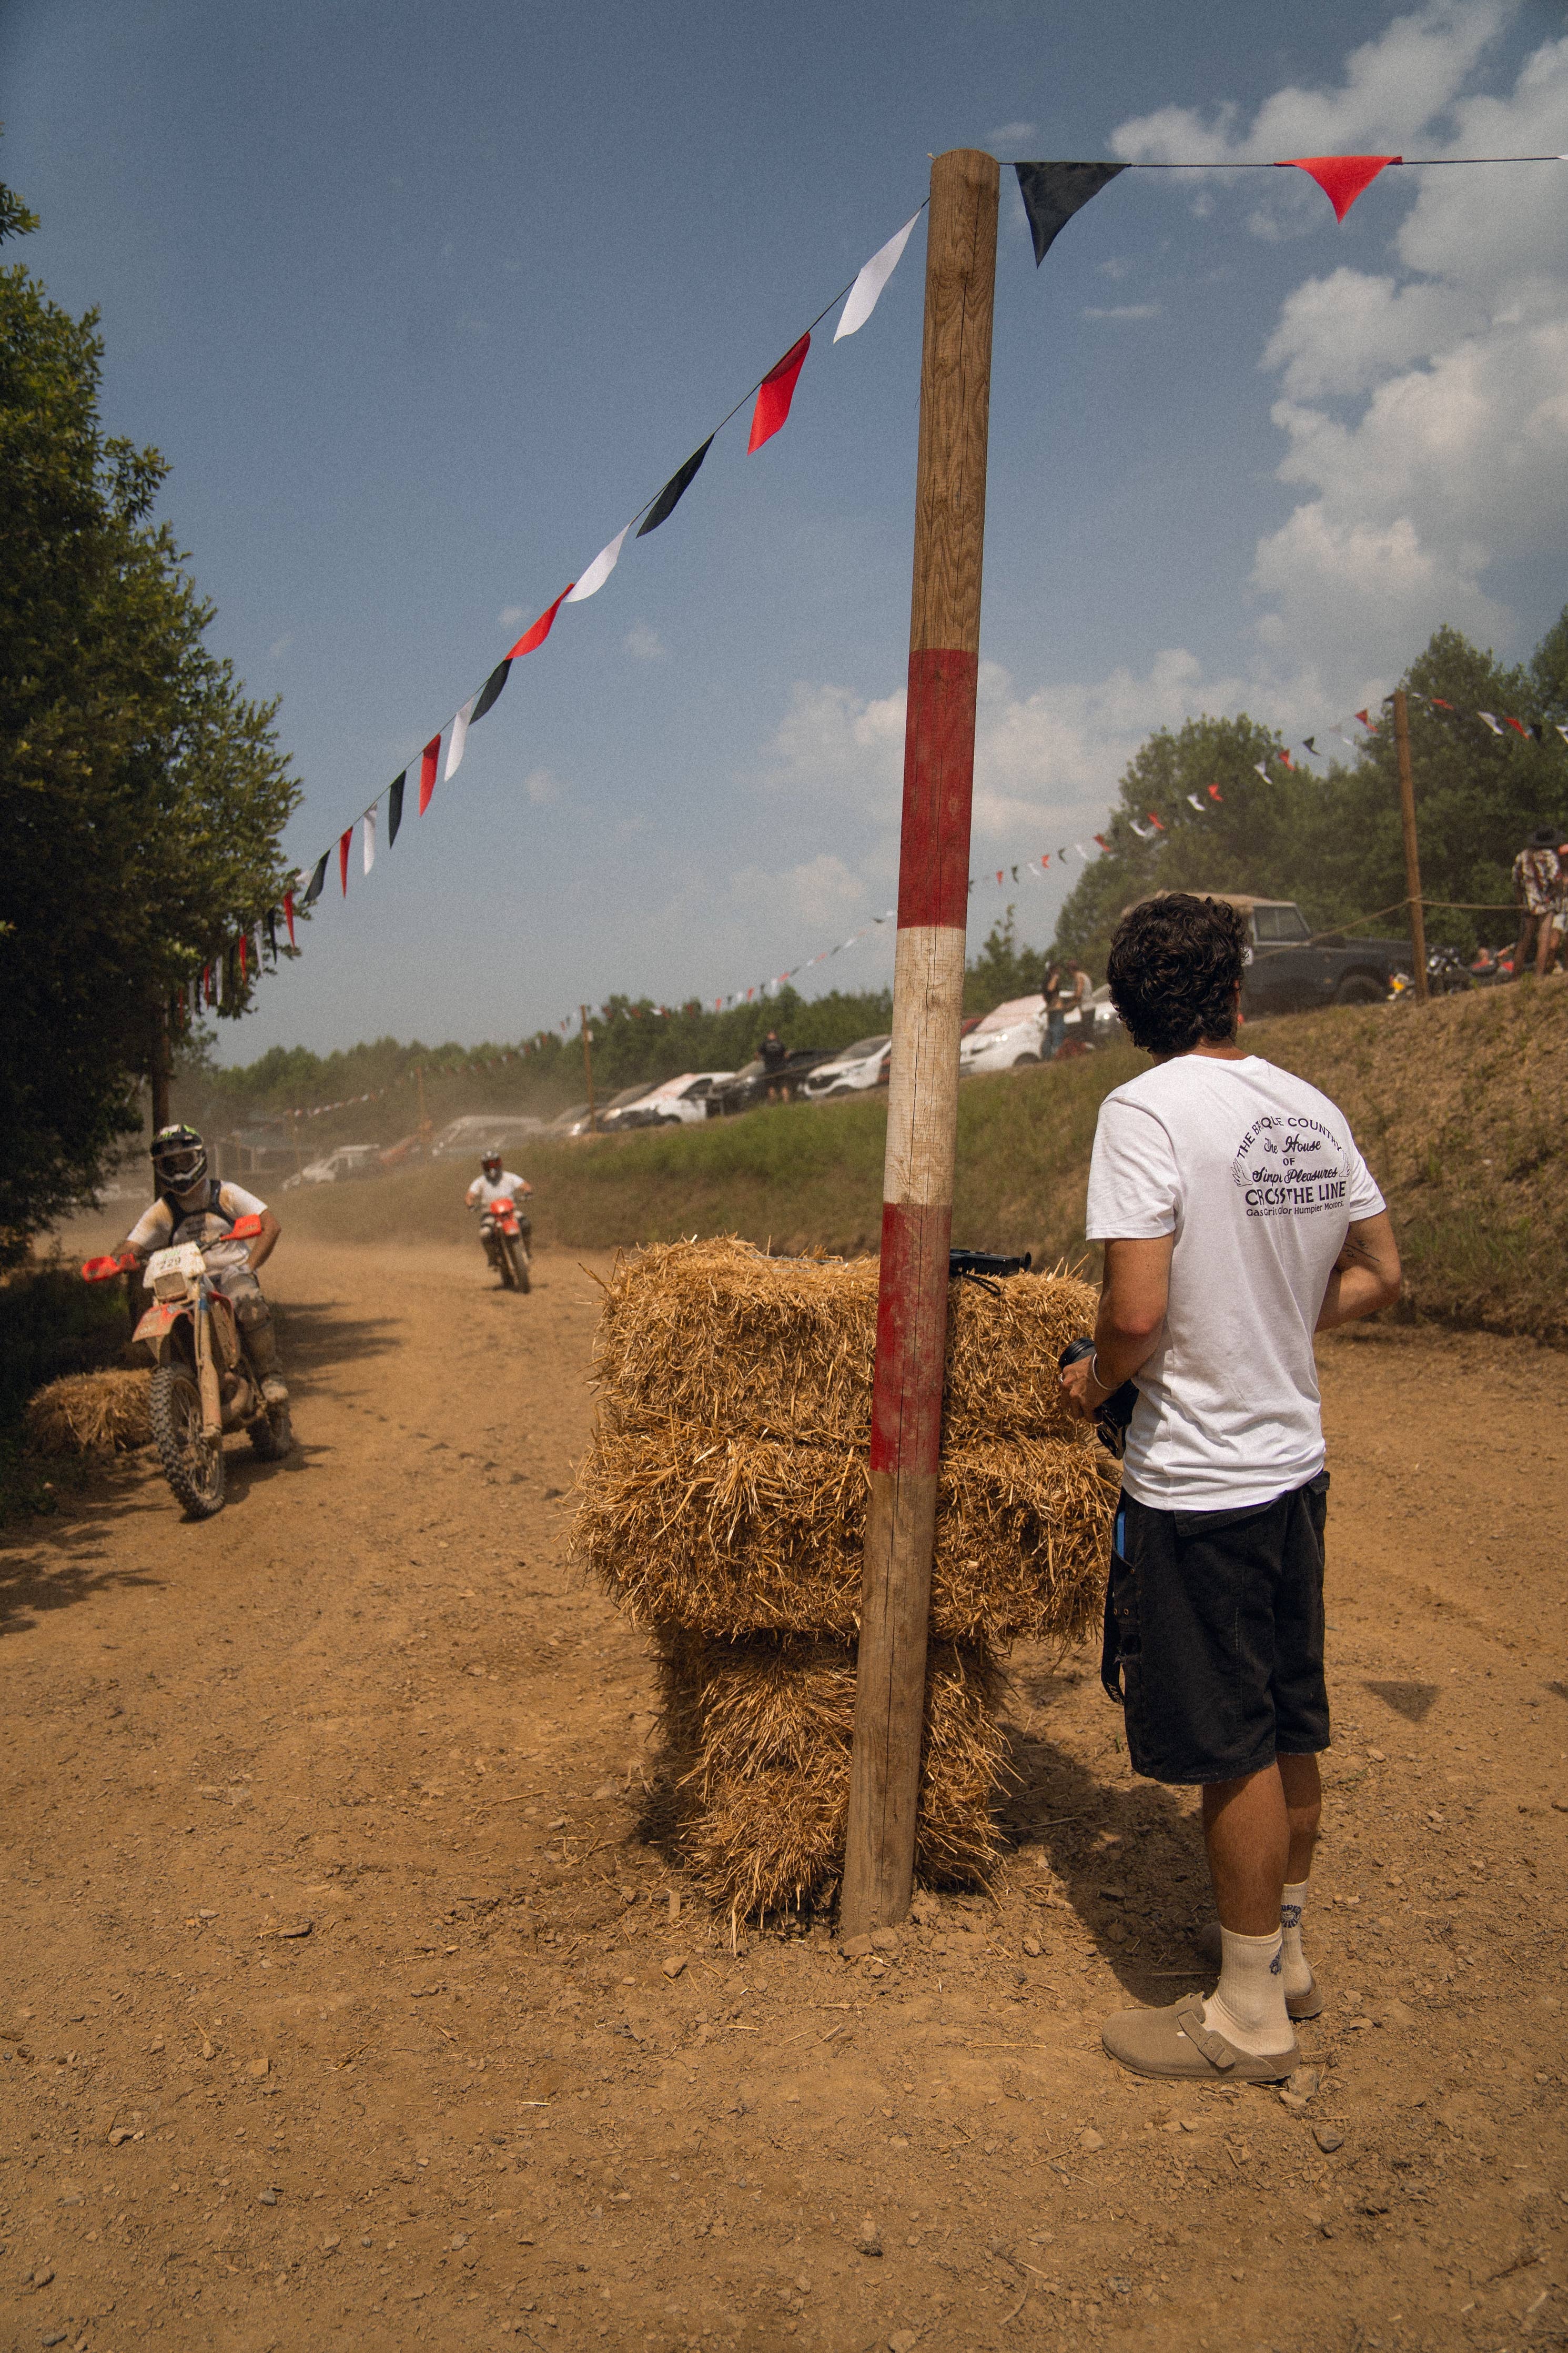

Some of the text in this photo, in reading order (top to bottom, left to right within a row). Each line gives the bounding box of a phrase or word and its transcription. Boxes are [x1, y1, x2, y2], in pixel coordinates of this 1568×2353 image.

[1237, 1116, 1342, 1159] THE BAQUE COUNTRY
[1264, 1133, 1321, 1154] The House
[1283, 1158, 1295, 1166] OF
[1284, 1167, 1338, 1183] Pleasures
[1286, 1186, 1314, 1204] THE
[1319, 1181, 1346, 1201] LINE
